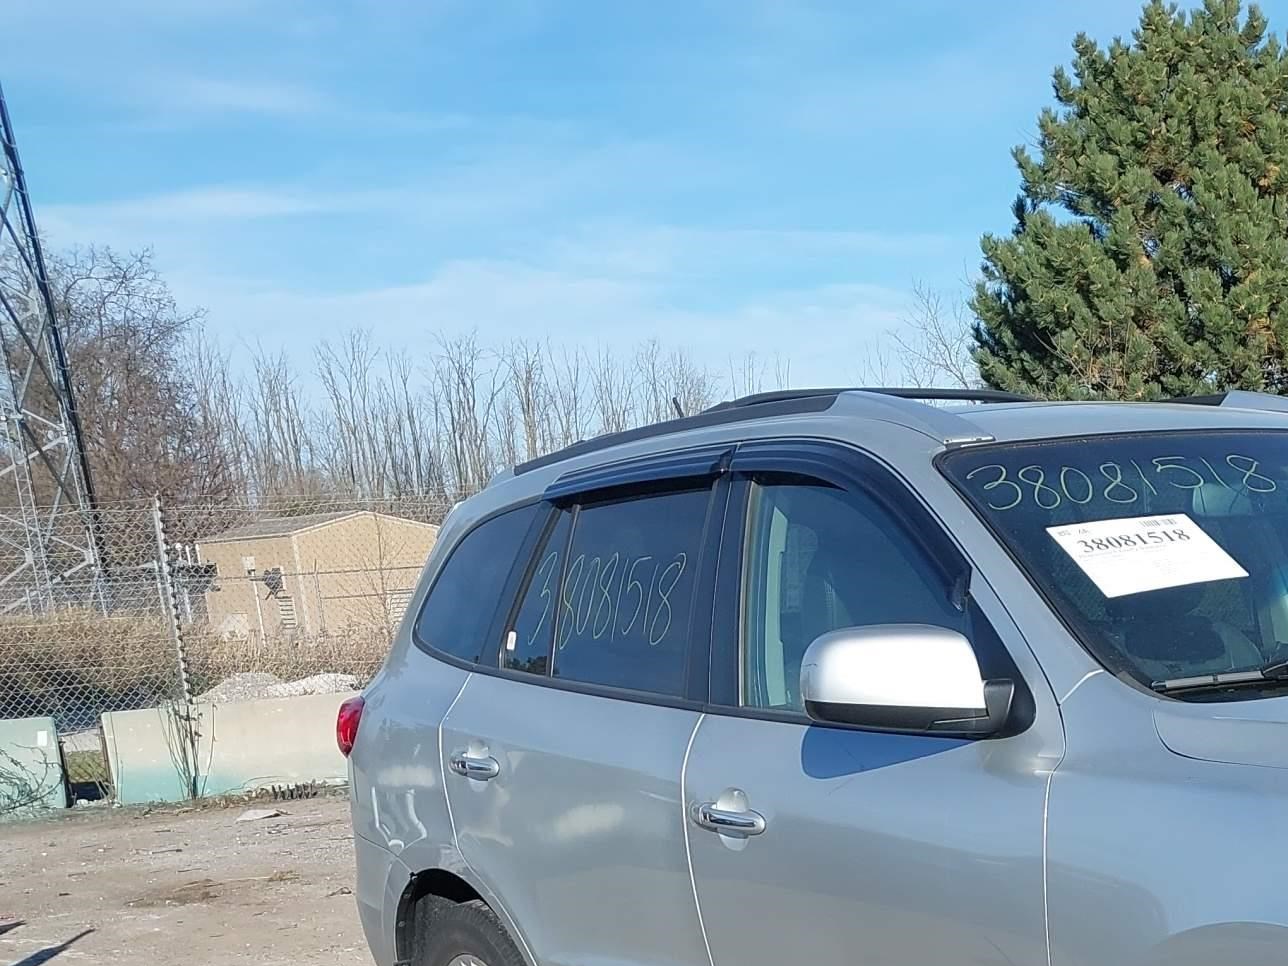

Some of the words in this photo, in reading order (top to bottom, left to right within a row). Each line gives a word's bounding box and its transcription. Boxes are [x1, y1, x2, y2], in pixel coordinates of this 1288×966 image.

[966, 454, 1277, 511] 38081518
[1077, 528, 1191, 553] 38081518
[527, 551, 687, 650] 38081518
